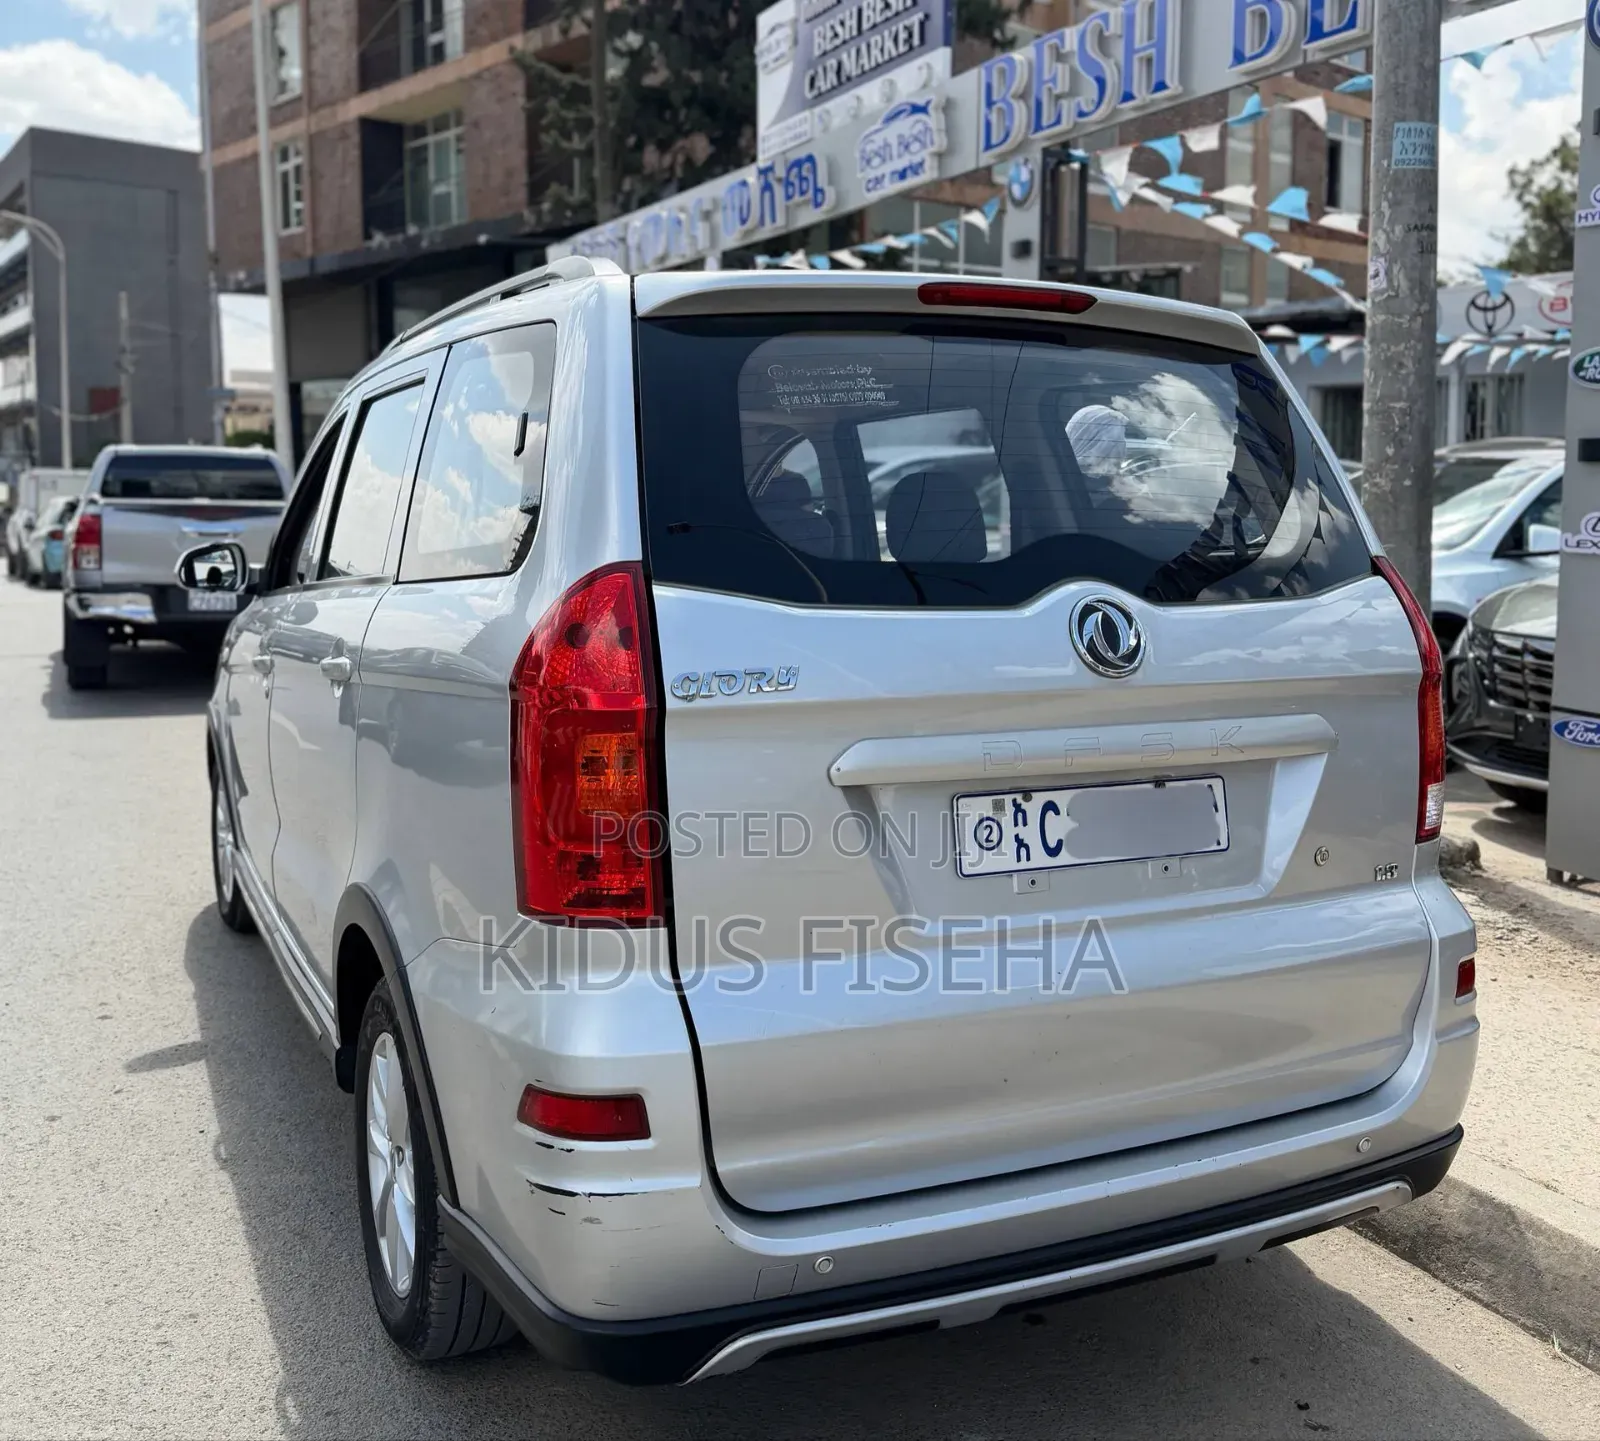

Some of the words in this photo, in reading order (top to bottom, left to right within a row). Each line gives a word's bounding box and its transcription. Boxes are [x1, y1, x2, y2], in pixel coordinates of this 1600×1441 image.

[803, 58, 839, 100] CAR
[839, 12, 928, 84] MARKET
[813, 5, 859, 58] BESH
[862, 0, 915, 32] BES
[981, 0, 1176, 155] BESH
[1578, 210, 1600, 223] HY
[670, 664, 800, 702] GLORY
